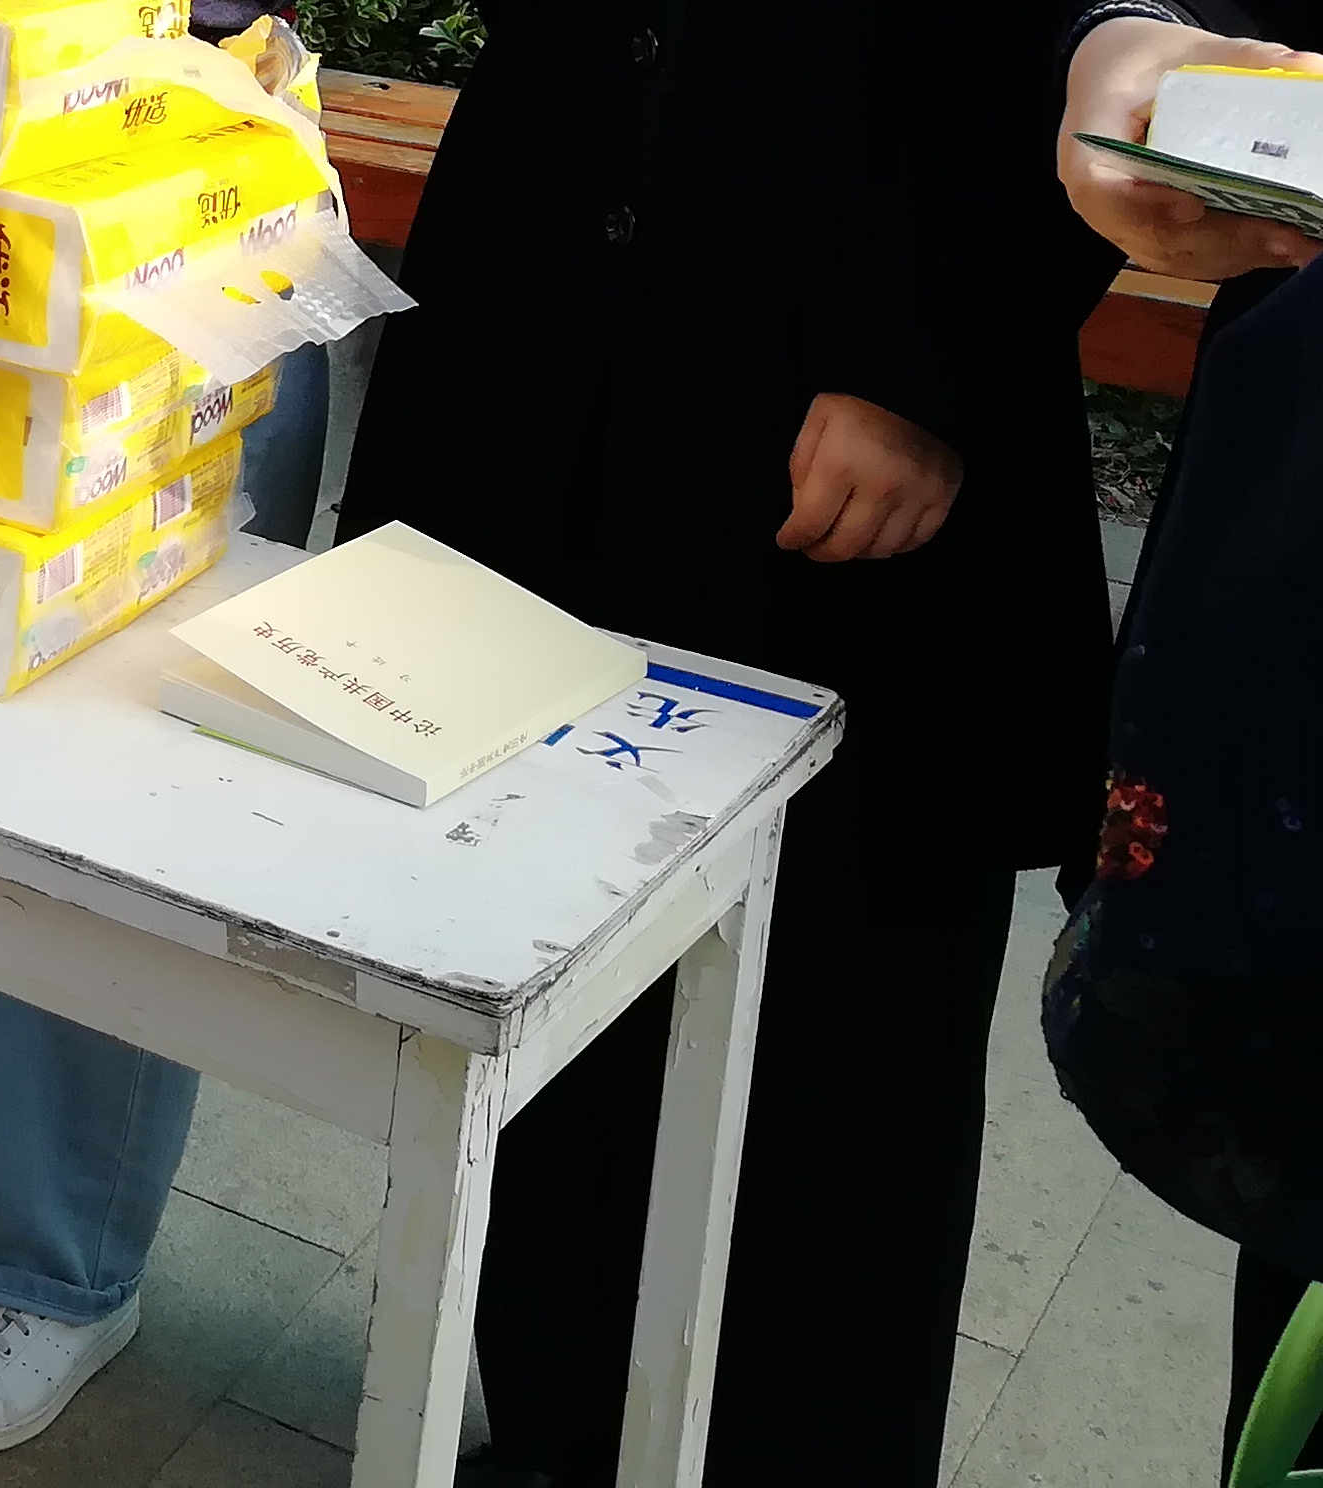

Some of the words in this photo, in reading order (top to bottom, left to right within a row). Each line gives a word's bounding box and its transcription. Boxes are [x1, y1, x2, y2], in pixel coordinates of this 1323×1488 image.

[252, 621, 445, 740] 论中国共产党历史
